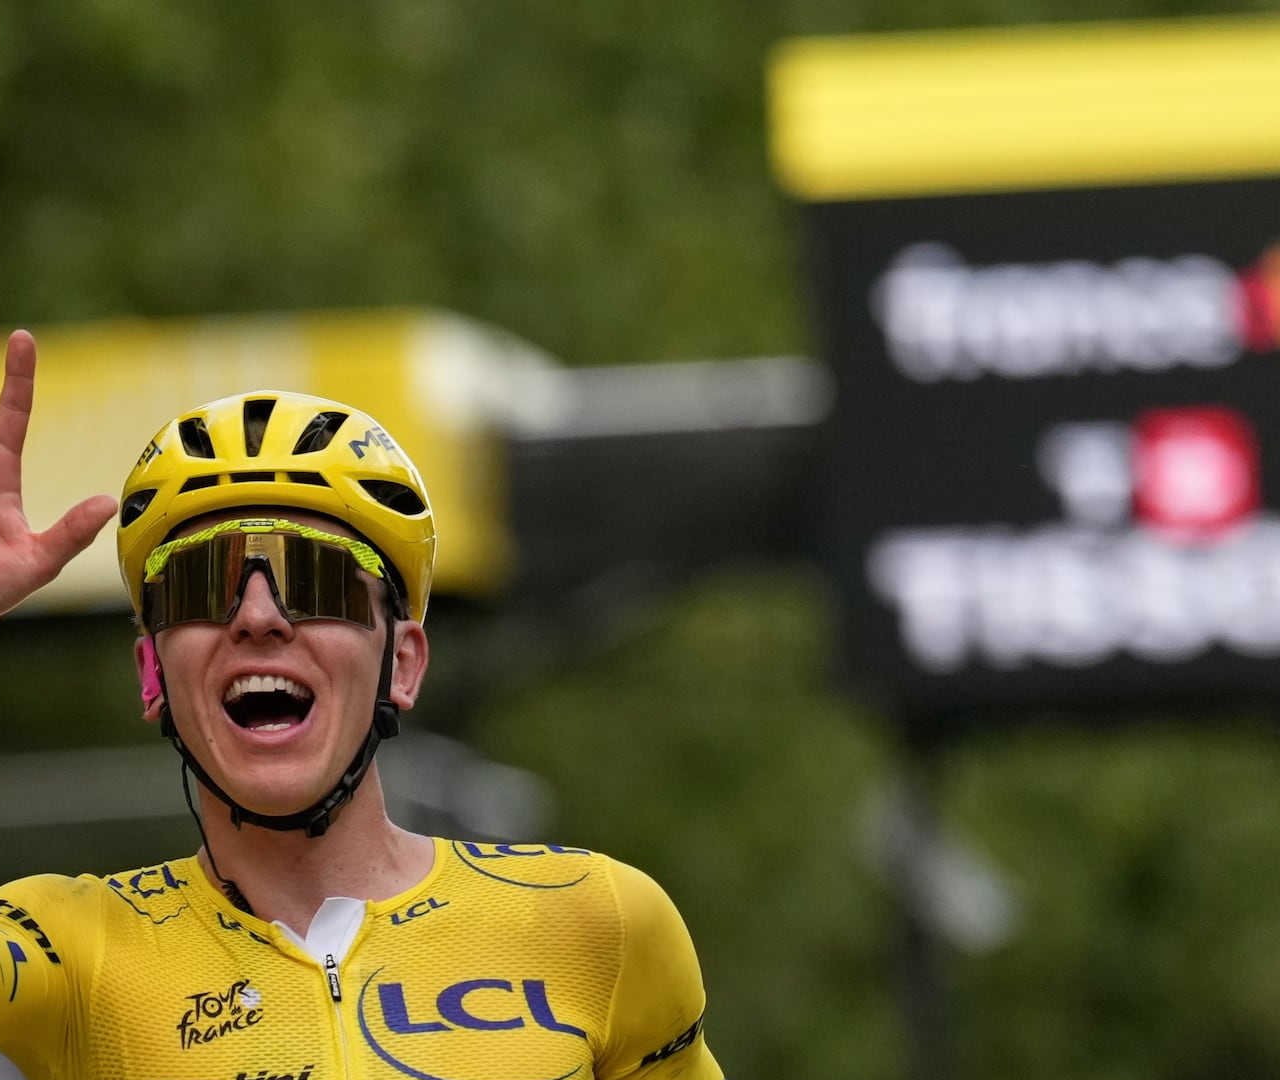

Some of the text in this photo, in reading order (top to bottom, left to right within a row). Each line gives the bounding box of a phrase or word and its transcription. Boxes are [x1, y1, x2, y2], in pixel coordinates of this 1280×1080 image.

[391, 897, 450, 926] LCL
[230, 1005, 243, 1016] de
[377, 978, 588, 1039] LCL
